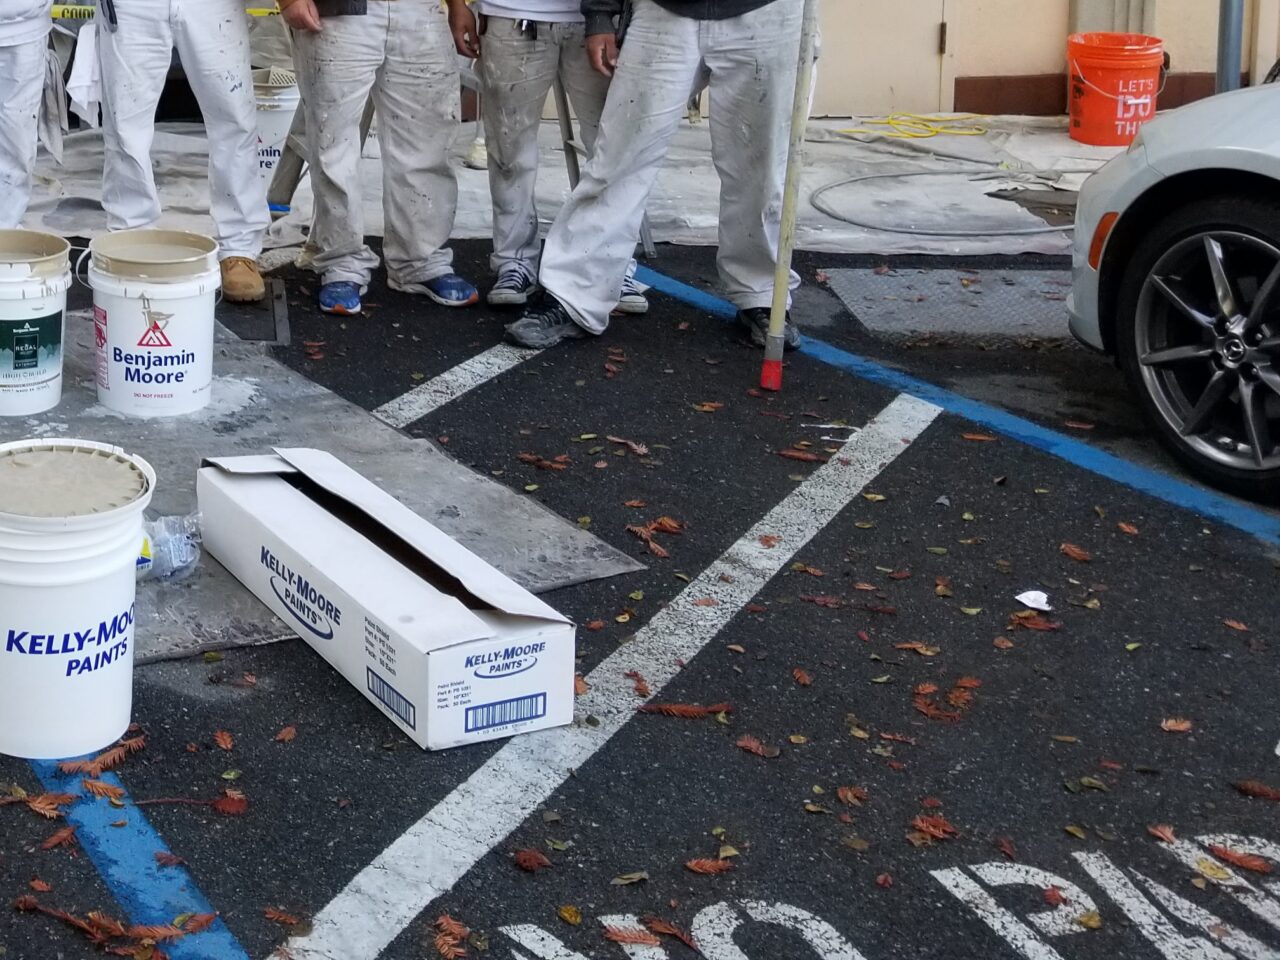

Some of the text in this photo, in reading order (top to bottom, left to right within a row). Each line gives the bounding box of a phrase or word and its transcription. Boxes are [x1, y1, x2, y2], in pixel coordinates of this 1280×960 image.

[1119, 79, 1154, 92] LET'S
[1117, 94, 1151, 119] DO
[1115, 120, 1141, 136] TH
[113, 346, 195, 370] Benjamin
[124, 366, 185, 384] Moore
[260, 546, 341, 626] KELLY-MOORE
[284, 588, 318, 625] PAINTS
[66, 638, 128, 677] PAINTS
[465, 642, 546, 669] KELLY-MOORE
[489, 659, 522, 674] PAINTS
